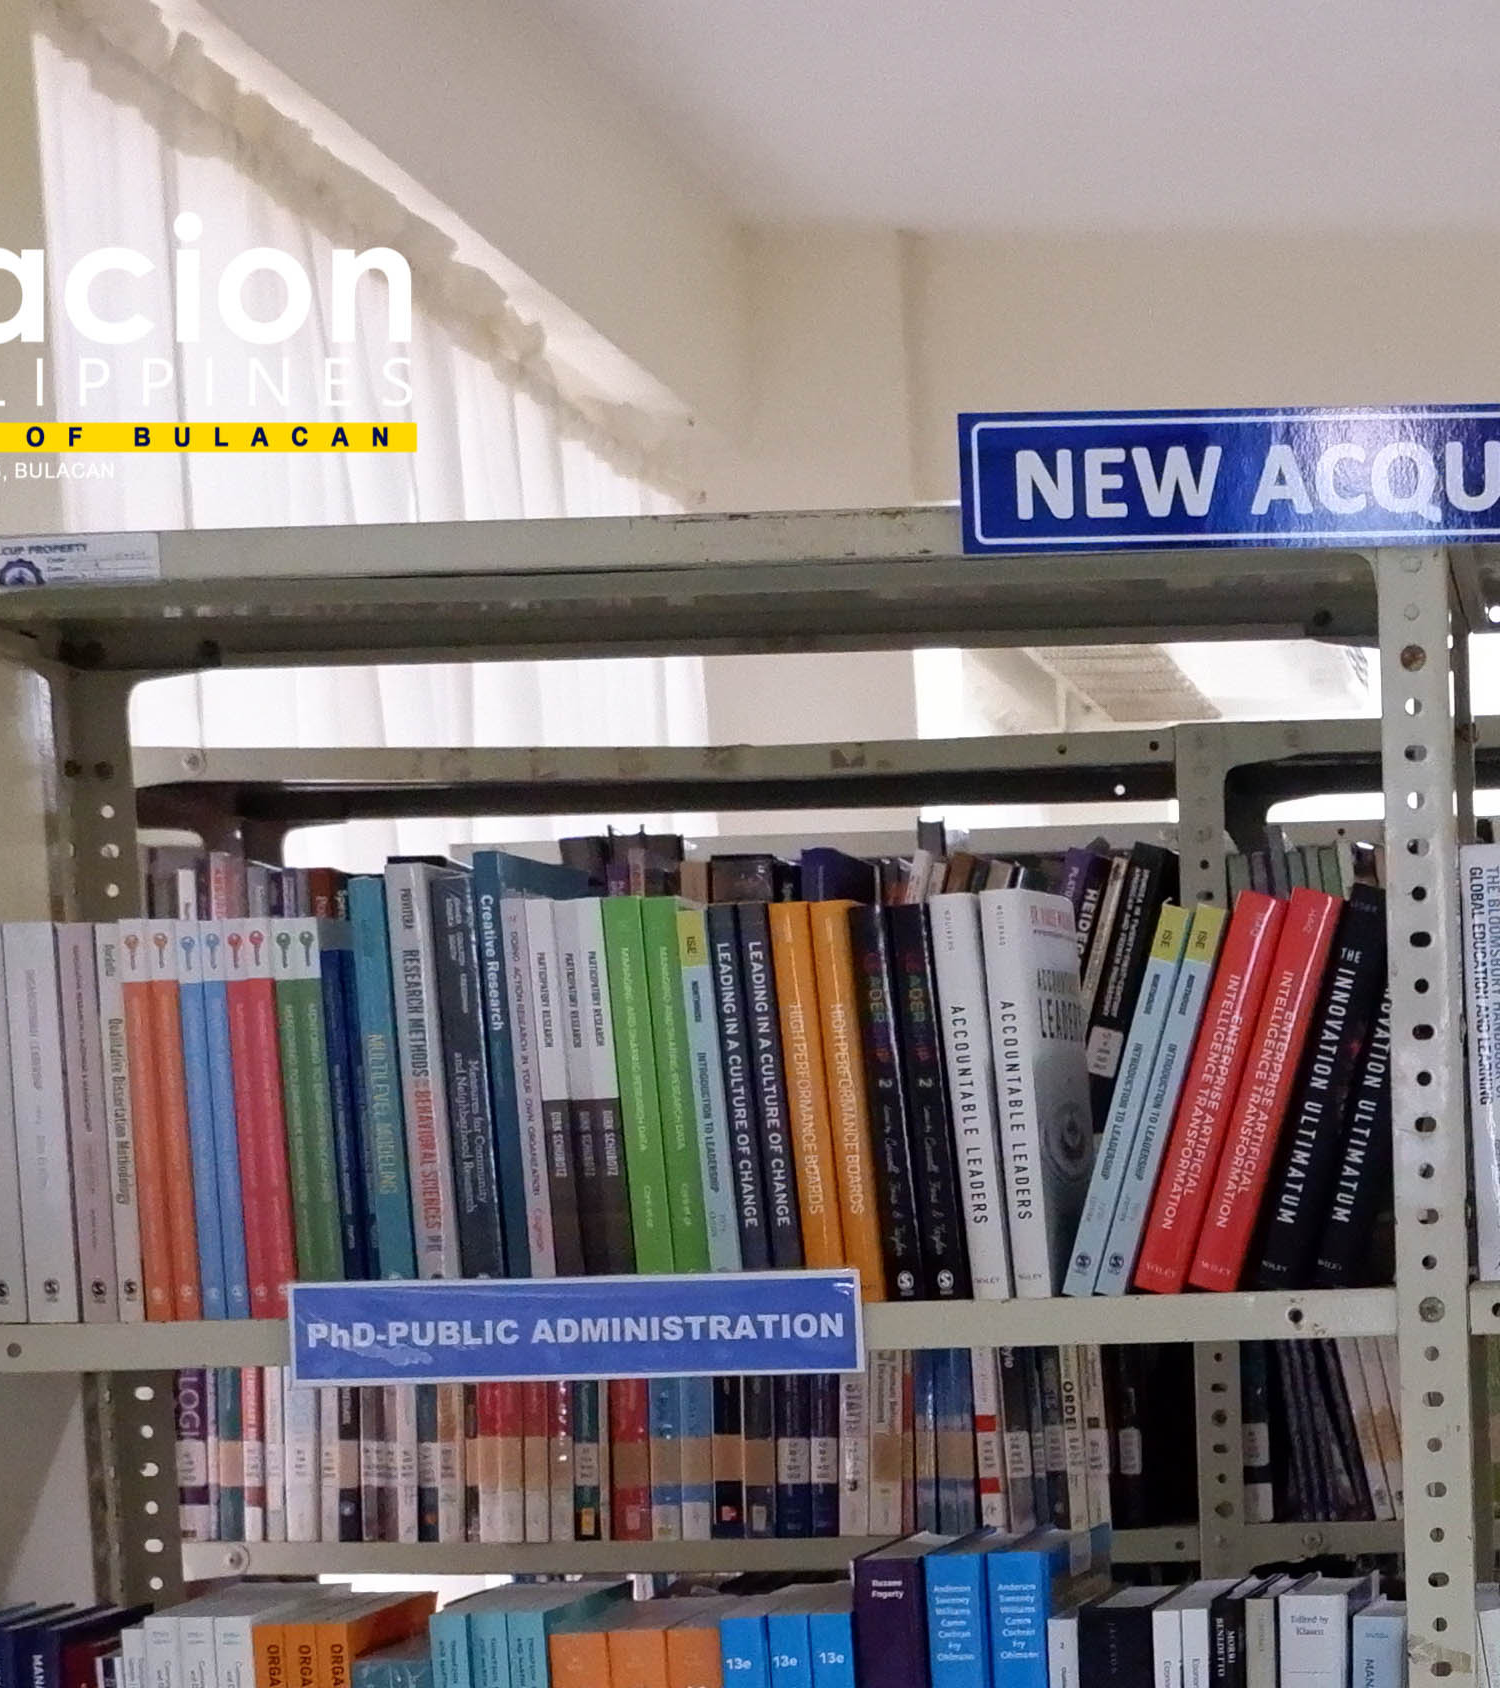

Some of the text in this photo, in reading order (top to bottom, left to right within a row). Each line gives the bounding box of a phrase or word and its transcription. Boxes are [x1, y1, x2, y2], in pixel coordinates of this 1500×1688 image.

[28, 543, 87, 554] PROPERTY
[1015, 445, 1222, 521] NEW
[479, 893, 504, 1030] Creative Research
[747, 940, 790, 1226] LEADING IN A CULTURE OF CHANGE
[997, 999, 1034, 1220] ACCOUNTABLE LEADERS
[1214, 969, 1294, 1229] INTELLIGENCE TRANSFORMATION
[1237, 1009, 1295, 1196] ENTERPRISE ARTIFICIAL
[1274, 946, 1362, 1224] THE INNOVATION ULTIMATUM
[308, 1313, 844, 1348] PhD-PUBLIC ADMINISTRATION
